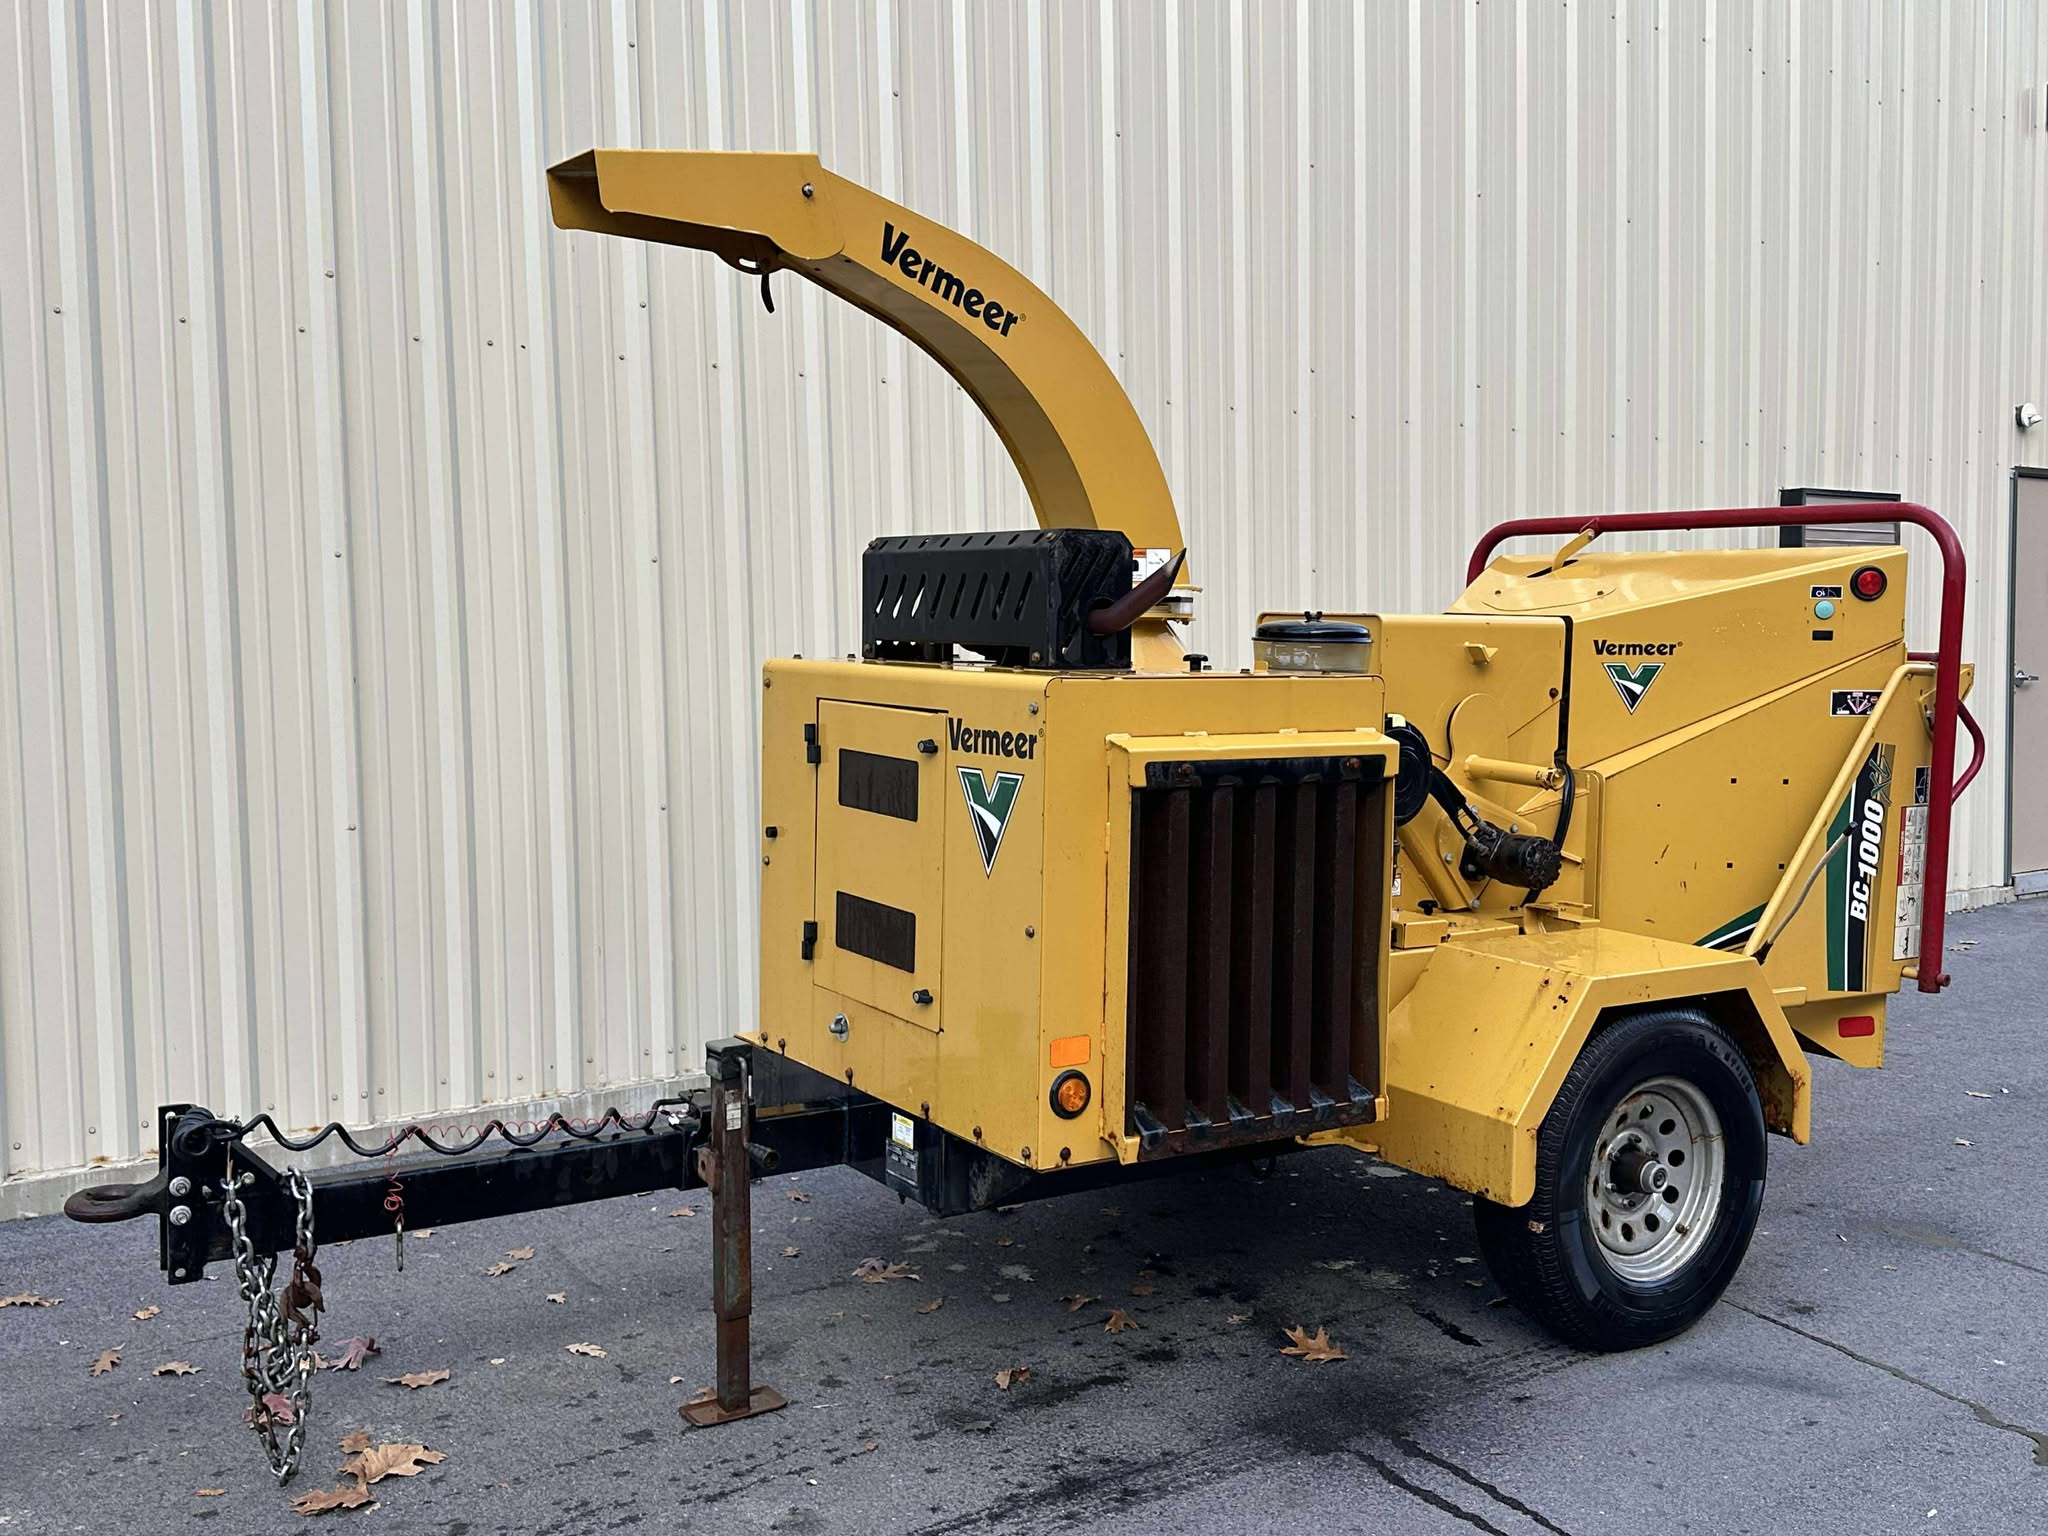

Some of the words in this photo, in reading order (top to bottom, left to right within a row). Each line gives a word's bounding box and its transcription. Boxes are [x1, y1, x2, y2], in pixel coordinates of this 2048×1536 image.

[880, 220, 1019, 338] Vermeer
[1592, 639, 1677, 656] Vermeer
[948, 717, 1038, 760] Vermeer
